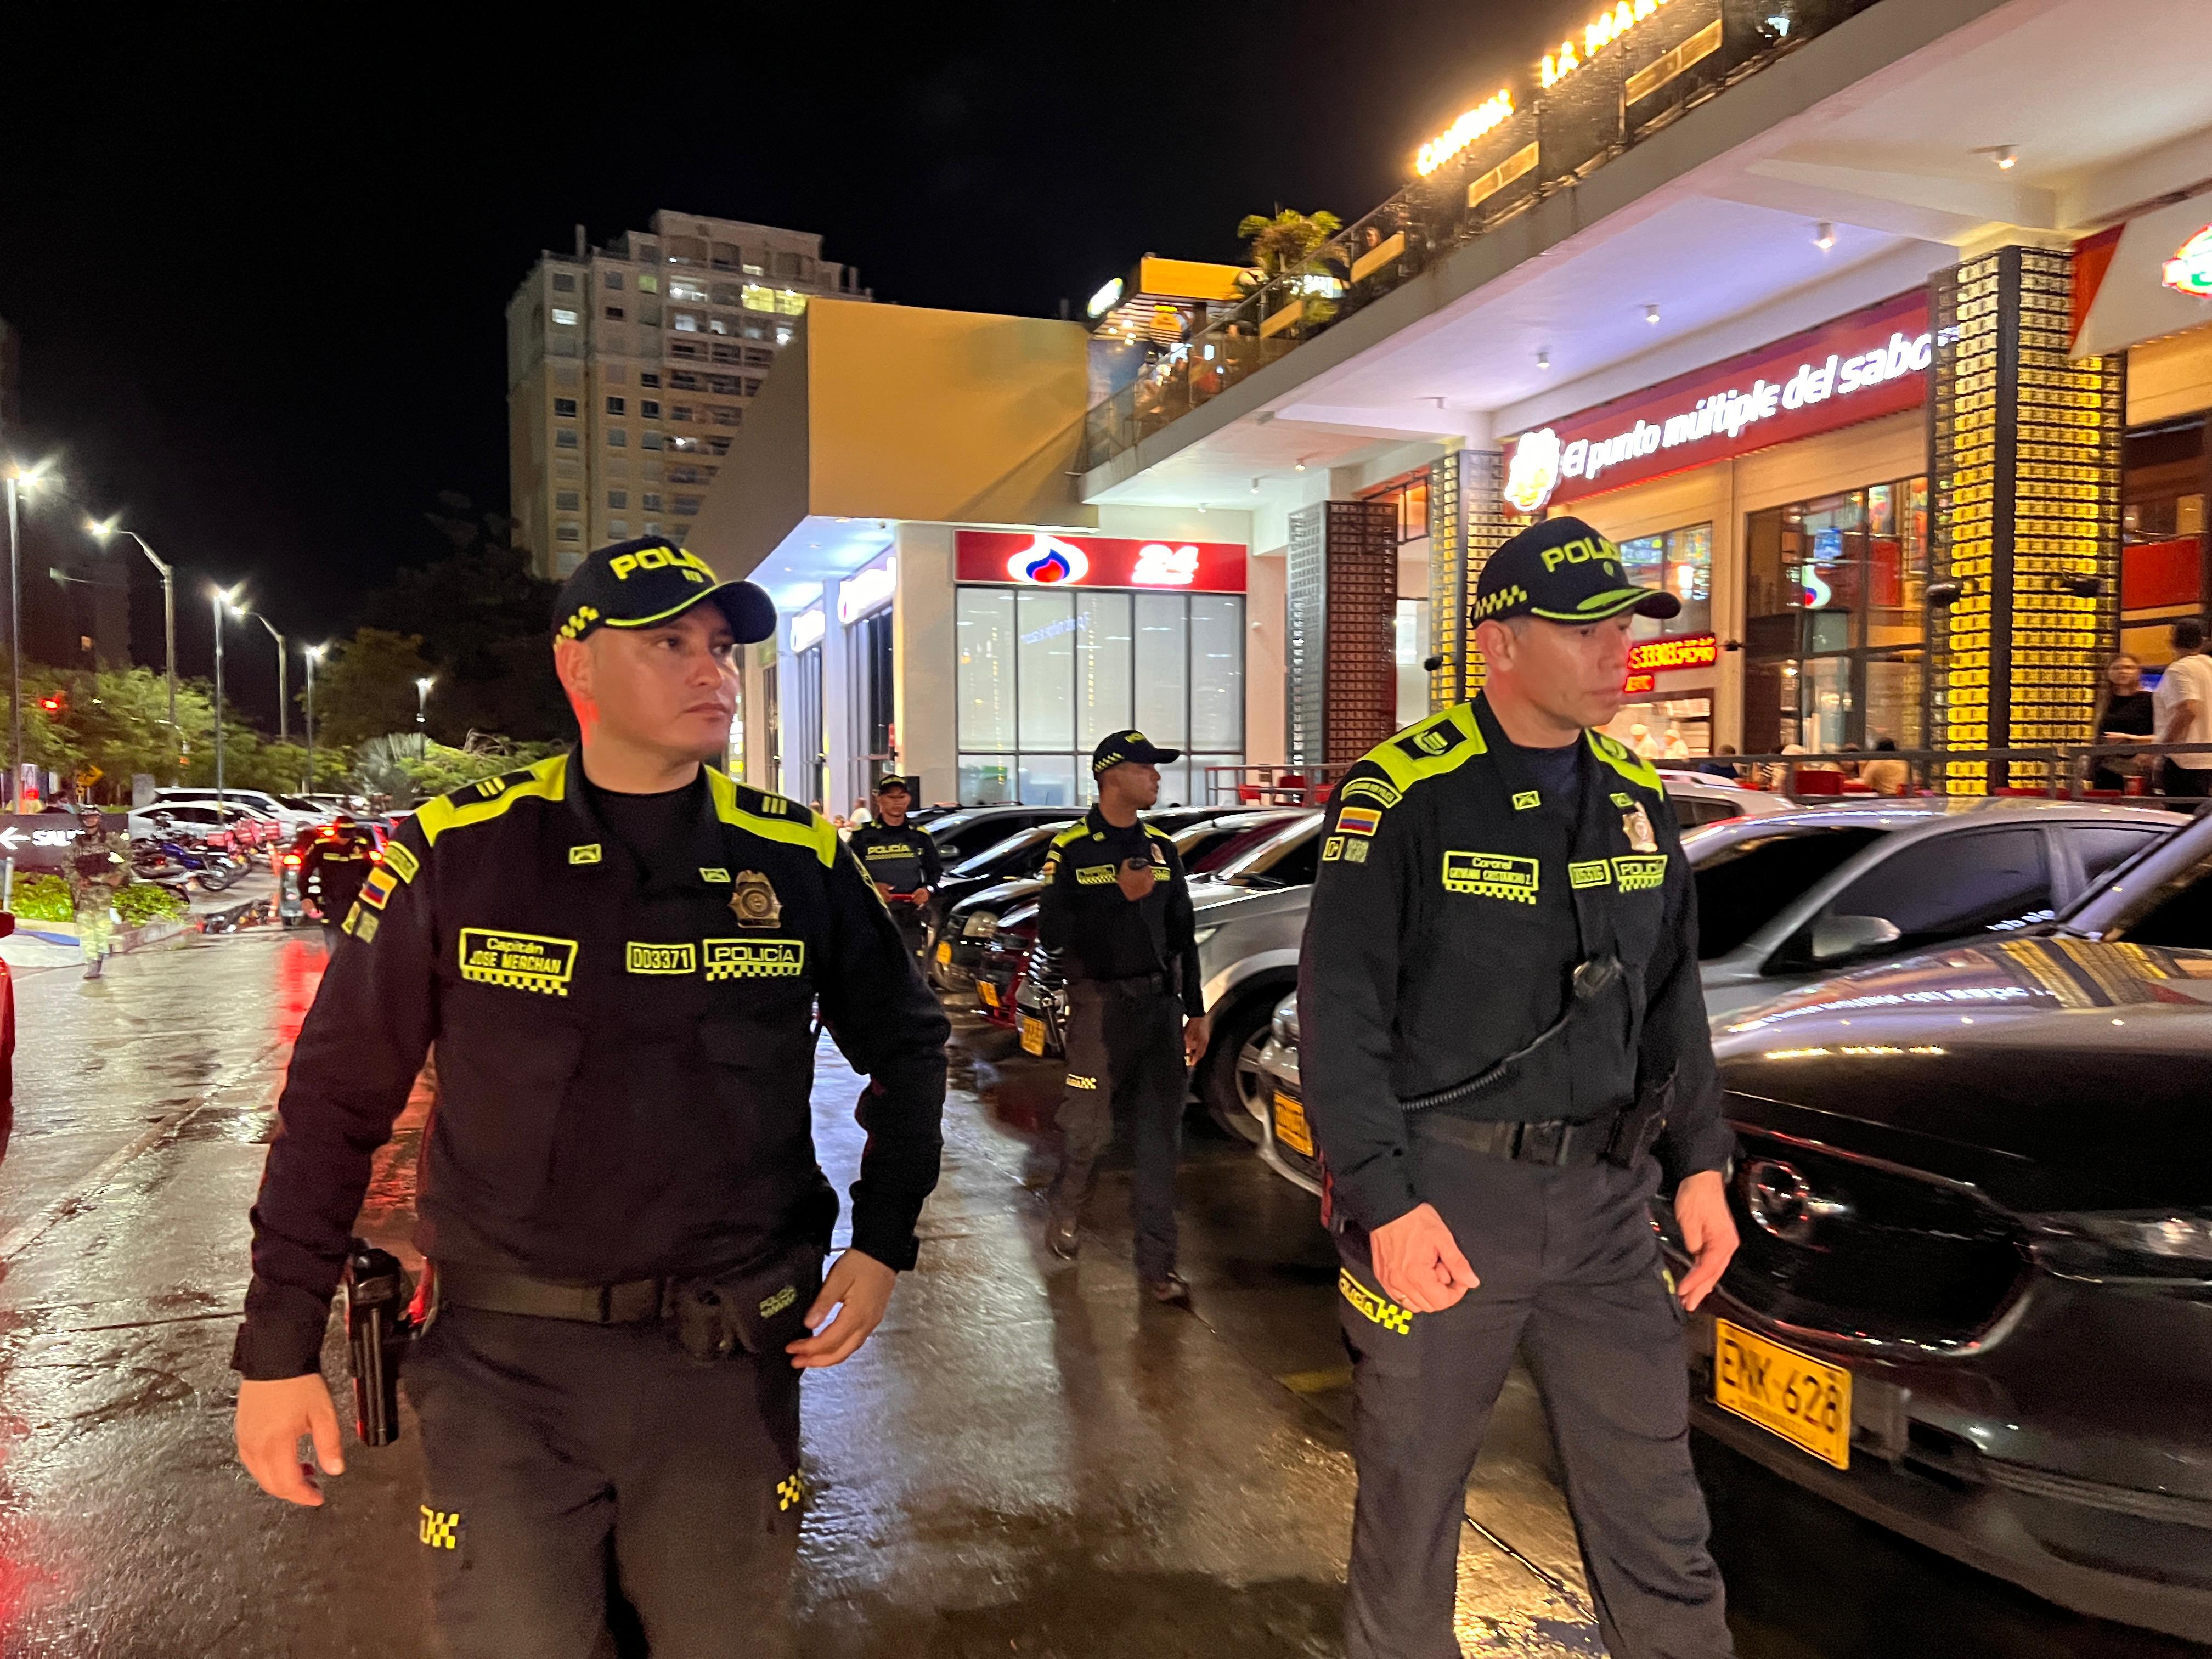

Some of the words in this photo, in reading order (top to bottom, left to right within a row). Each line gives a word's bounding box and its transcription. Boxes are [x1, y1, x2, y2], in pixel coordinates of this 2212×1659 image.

[1562, 439, 1588, 477] El
[1586, 420, 1661, 479] punto
[1662, 379, 1781, 447] múltiple
[1782, 354, 1838, 409] del
[715, 945, 795, 962] POLICÍA
